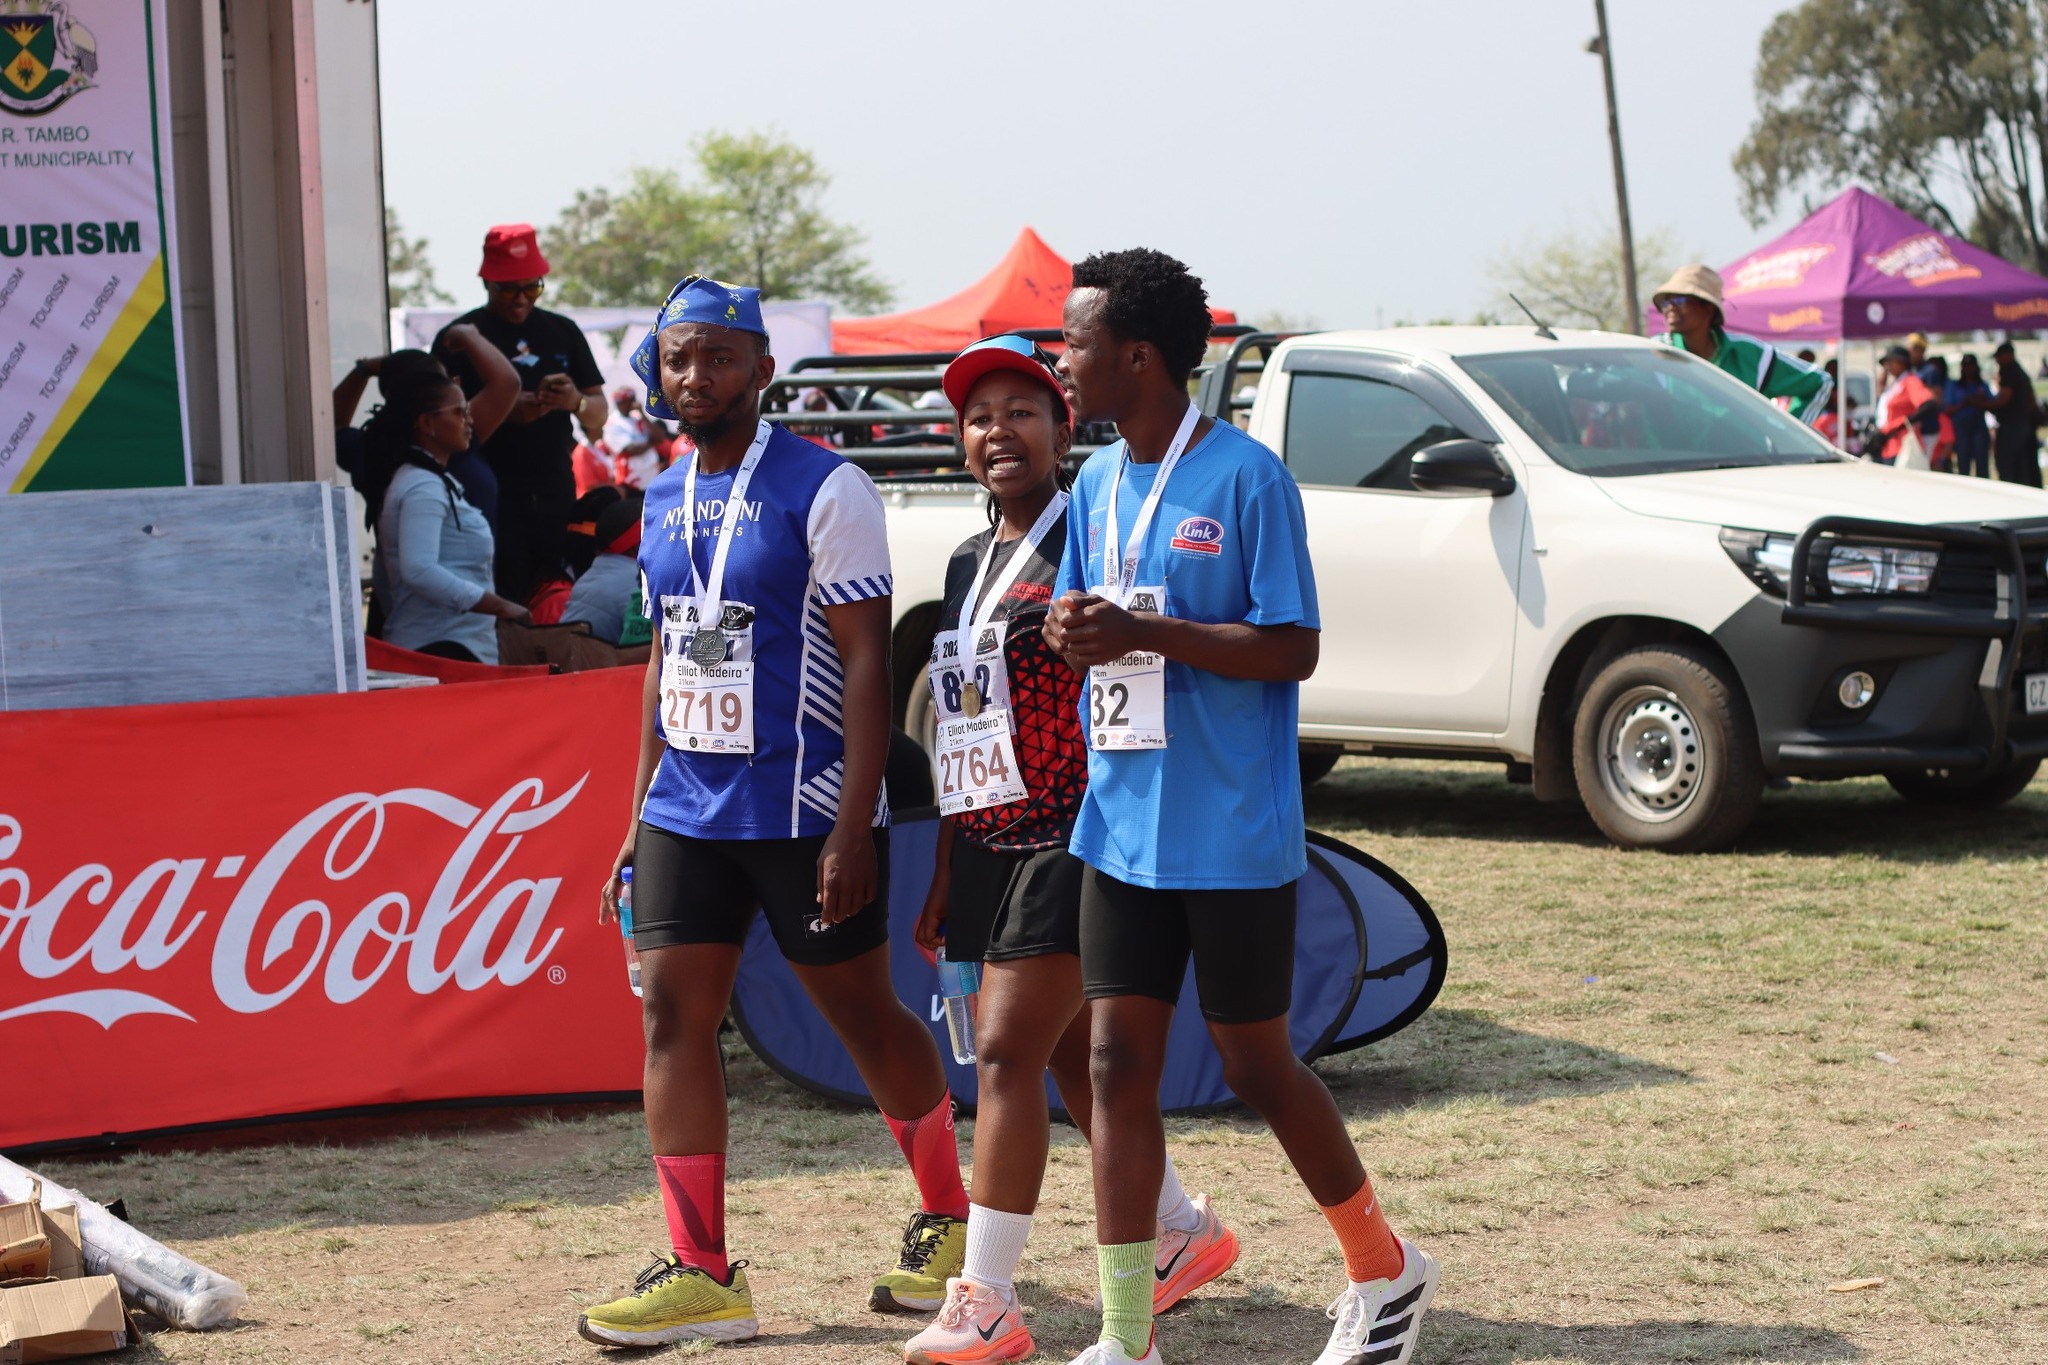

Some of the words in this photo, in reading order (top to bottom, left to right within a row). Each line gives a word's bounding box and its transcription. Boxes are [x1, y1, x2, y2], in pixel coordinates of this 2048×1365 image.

[24, 125, 90, 143] TAMBO
[14, 150, 134, 168] MUNICIPALITY
[30, 272, 70, 329] TOURISM
[80, 274, 120, 331] TOURISM
[0, 340, 27, 390] URISM
[39, 342, 79, 399] TOURISM
[662, 499, 763, 529] NYNDNI
[669, 526, 743, 542] RUNNES
[1183, 521, 1212, 540] Link
[1130, 596, 1156, 610] ASA
[979, 631, 994, 644] SA
[943, 639, 959, 659] 202
[678, 665, 698, 677] Elliot
[700, 666, 742, 678] Madeira
[666, 688, 742, 733] 2719
[947, 723, 965, 737] Elliot
[966, 717, 999, 733] Madeira
[940, 741, 1009, 795] 2764
